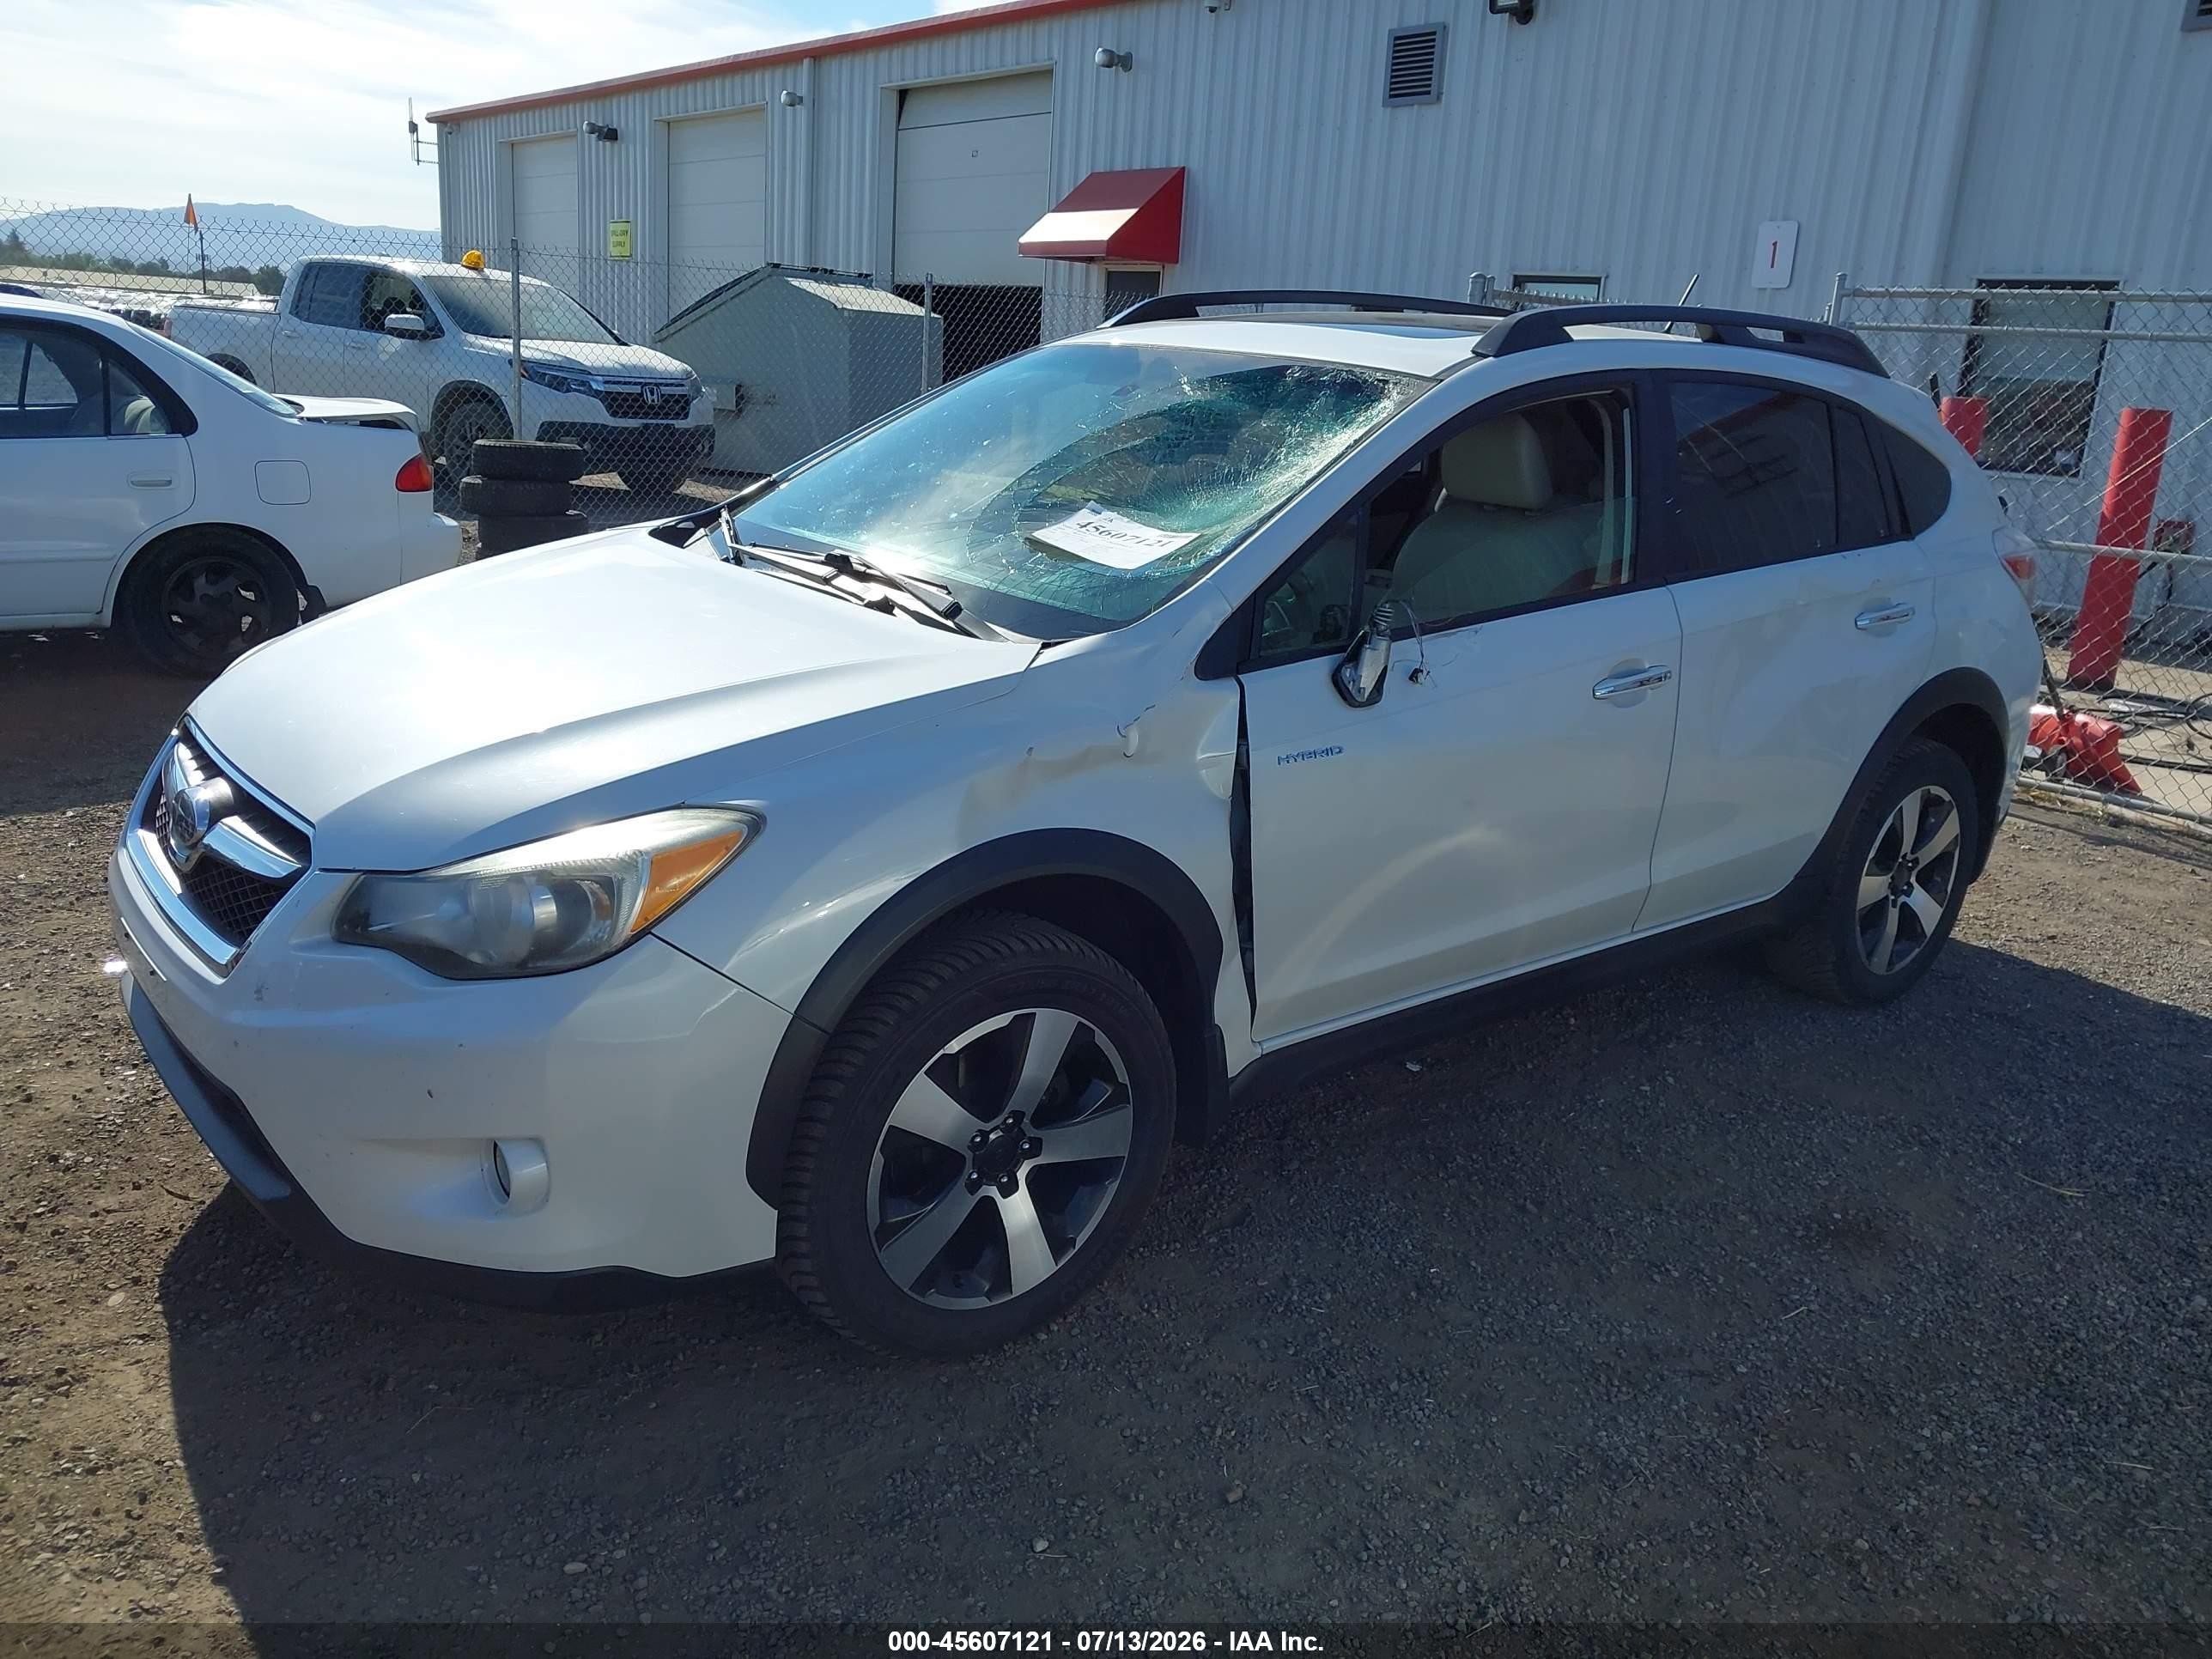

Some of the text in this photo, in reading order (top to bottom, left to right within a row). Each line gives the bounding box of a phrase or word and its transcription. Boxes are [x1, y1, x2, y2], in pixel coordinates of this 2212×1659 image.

[1771, 240, 1778, 268] 1
[1076, 521, 1173, 547] 45607121
[1277, 745, 1344, 766] HYBRID
